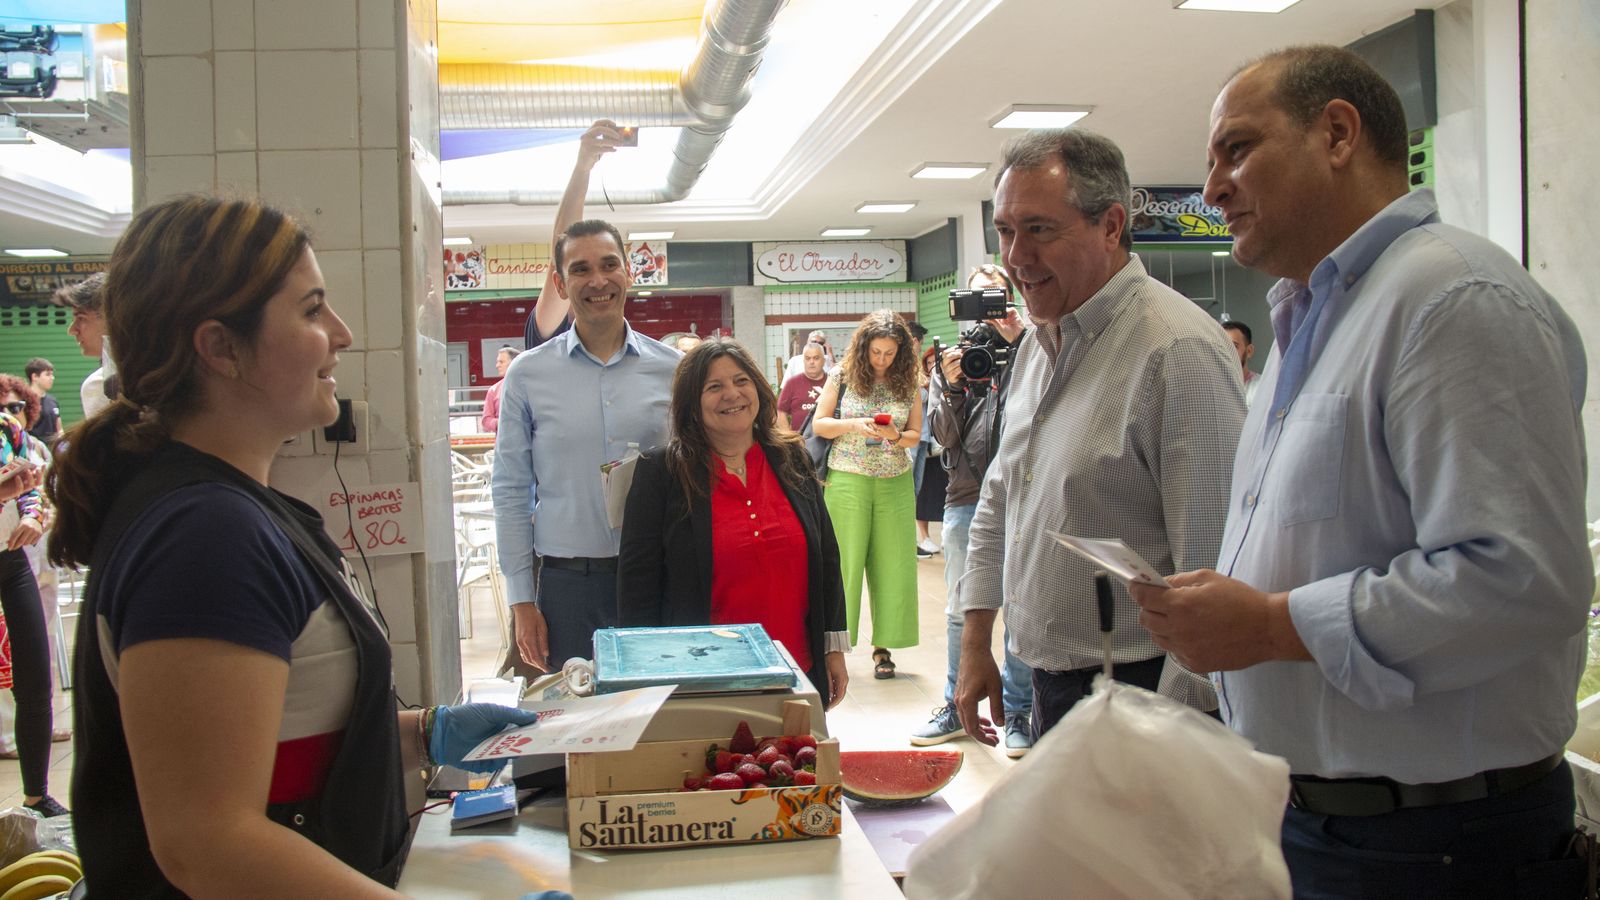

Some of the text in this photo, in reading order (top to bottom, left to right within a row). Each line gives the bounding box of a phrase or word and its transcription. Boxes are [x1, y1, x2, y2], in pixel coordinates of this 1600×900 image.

[0, 263, 51, 273] DIRECTO
[55, 263, 70, 273] AL
[778, 252, 884, 271] El Obrador
[358, 502, 402, 519] BROTES
[598, 800, 640, 825] La
[637, 801, 675, 810] premium
[647, 809, 676, 817] berries
[579, 813, 734, 847] Santanera
